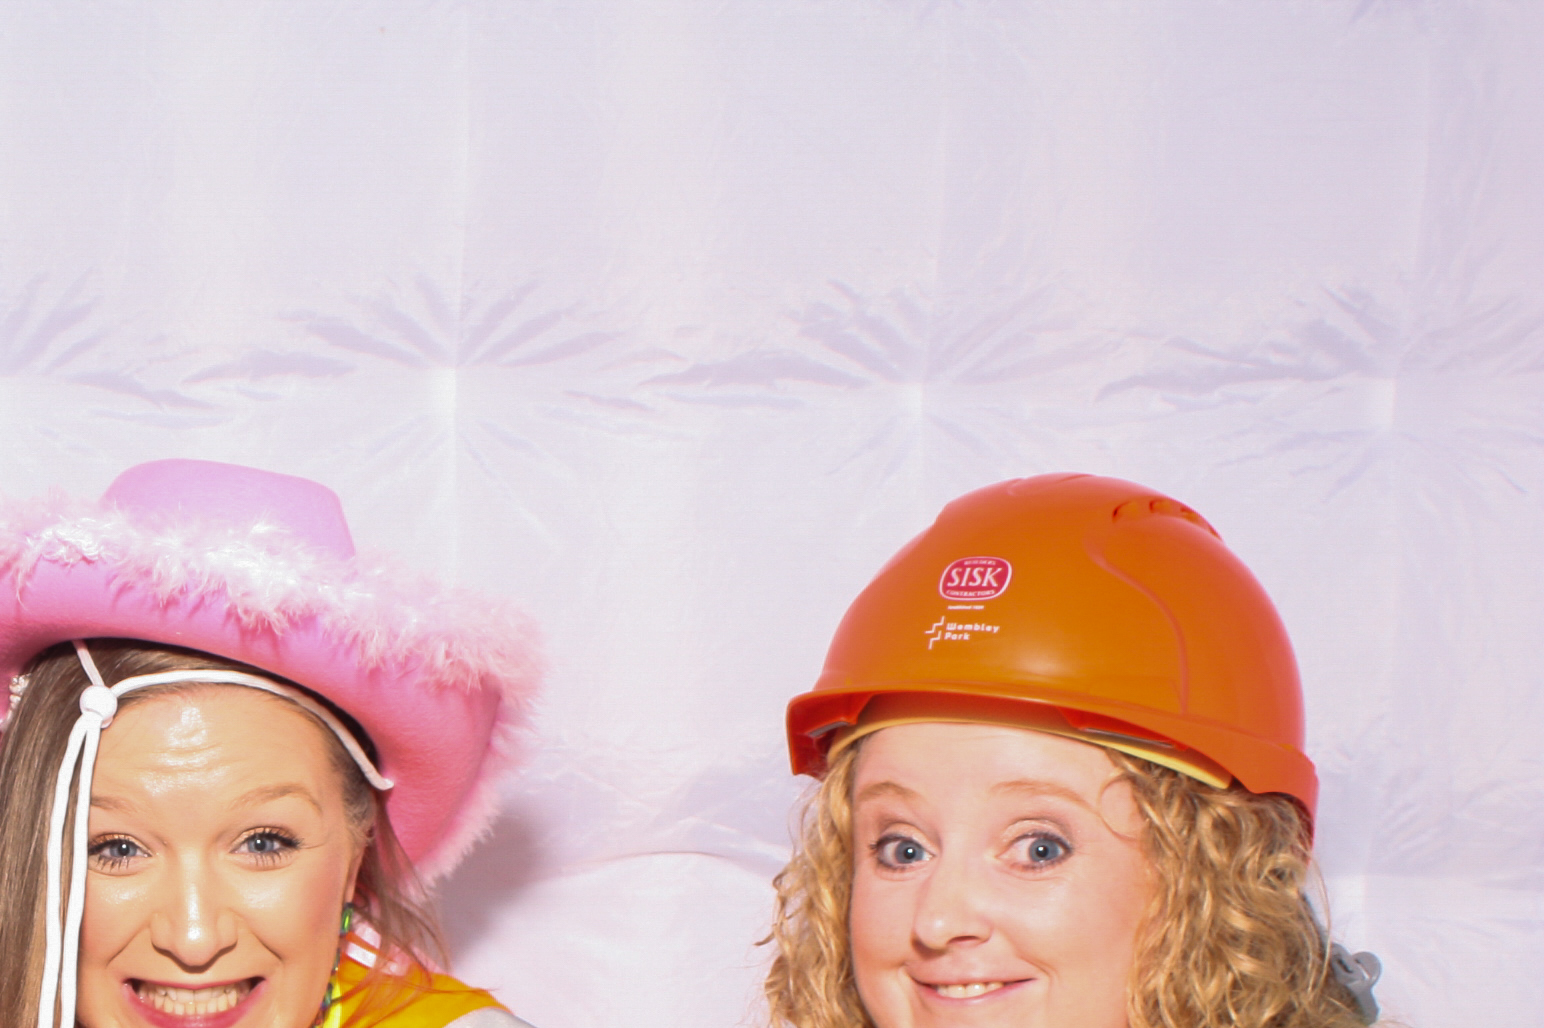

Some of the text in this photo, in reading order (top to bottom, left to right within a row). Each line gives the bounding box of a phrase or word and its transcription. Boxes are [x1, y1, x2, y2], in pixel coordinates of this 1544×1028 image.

[947, 567, 1002, 587] SISK
[946, 622, 1000, 633] Wembley
[945, 632, 970, 640] Park
